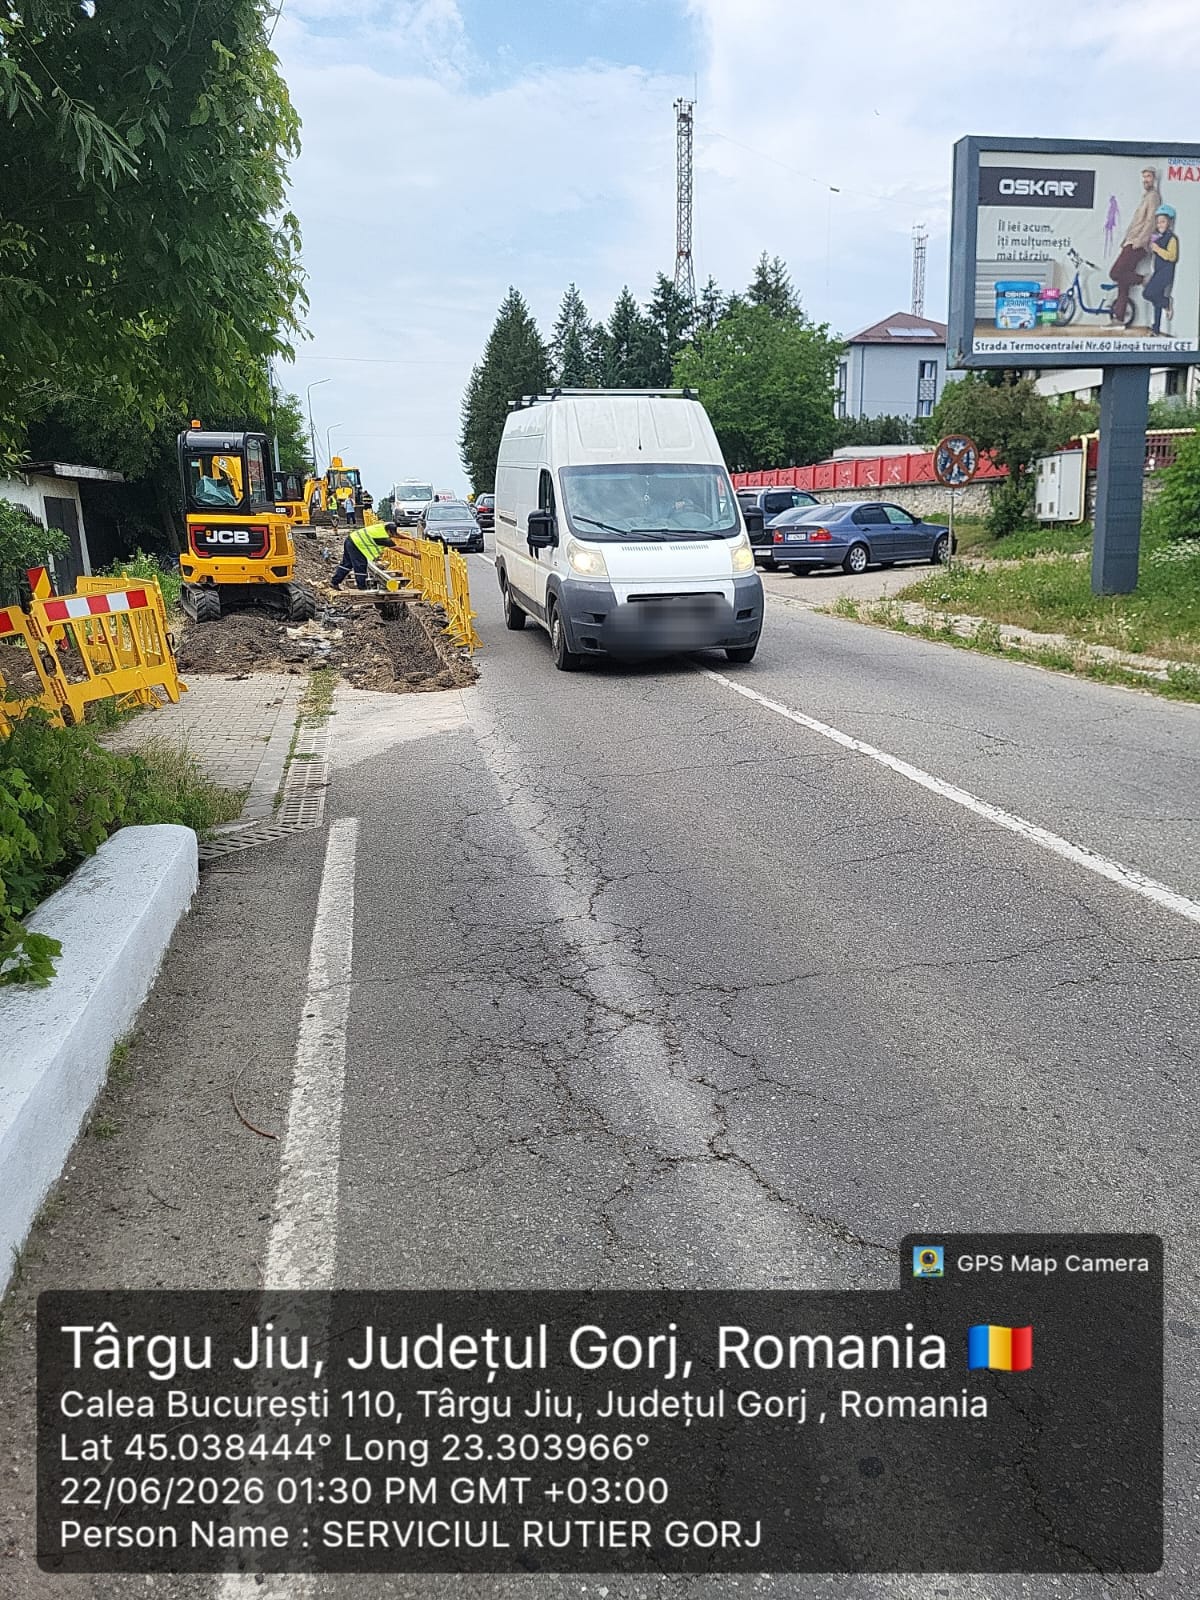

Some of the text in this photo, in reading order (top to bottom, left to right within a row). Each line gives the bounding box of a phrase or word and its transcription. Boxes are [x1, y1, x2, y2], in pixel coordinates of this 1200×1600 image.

[999, 179, 1076, 197] OSKAR
[1007, 221, 1021, 232] iei
[996, 250, 1016, 261] mai
[974, 341, 1008, 351] Strada
[1010, 340, 1083, 350] Termocentralei
[1085, 341, 1111, 351] Nr.60
[1142, 341, 1172, 351] turnul
[1173, 342, 1193, 351] CET
[205, 530, 250, 544] JCB
